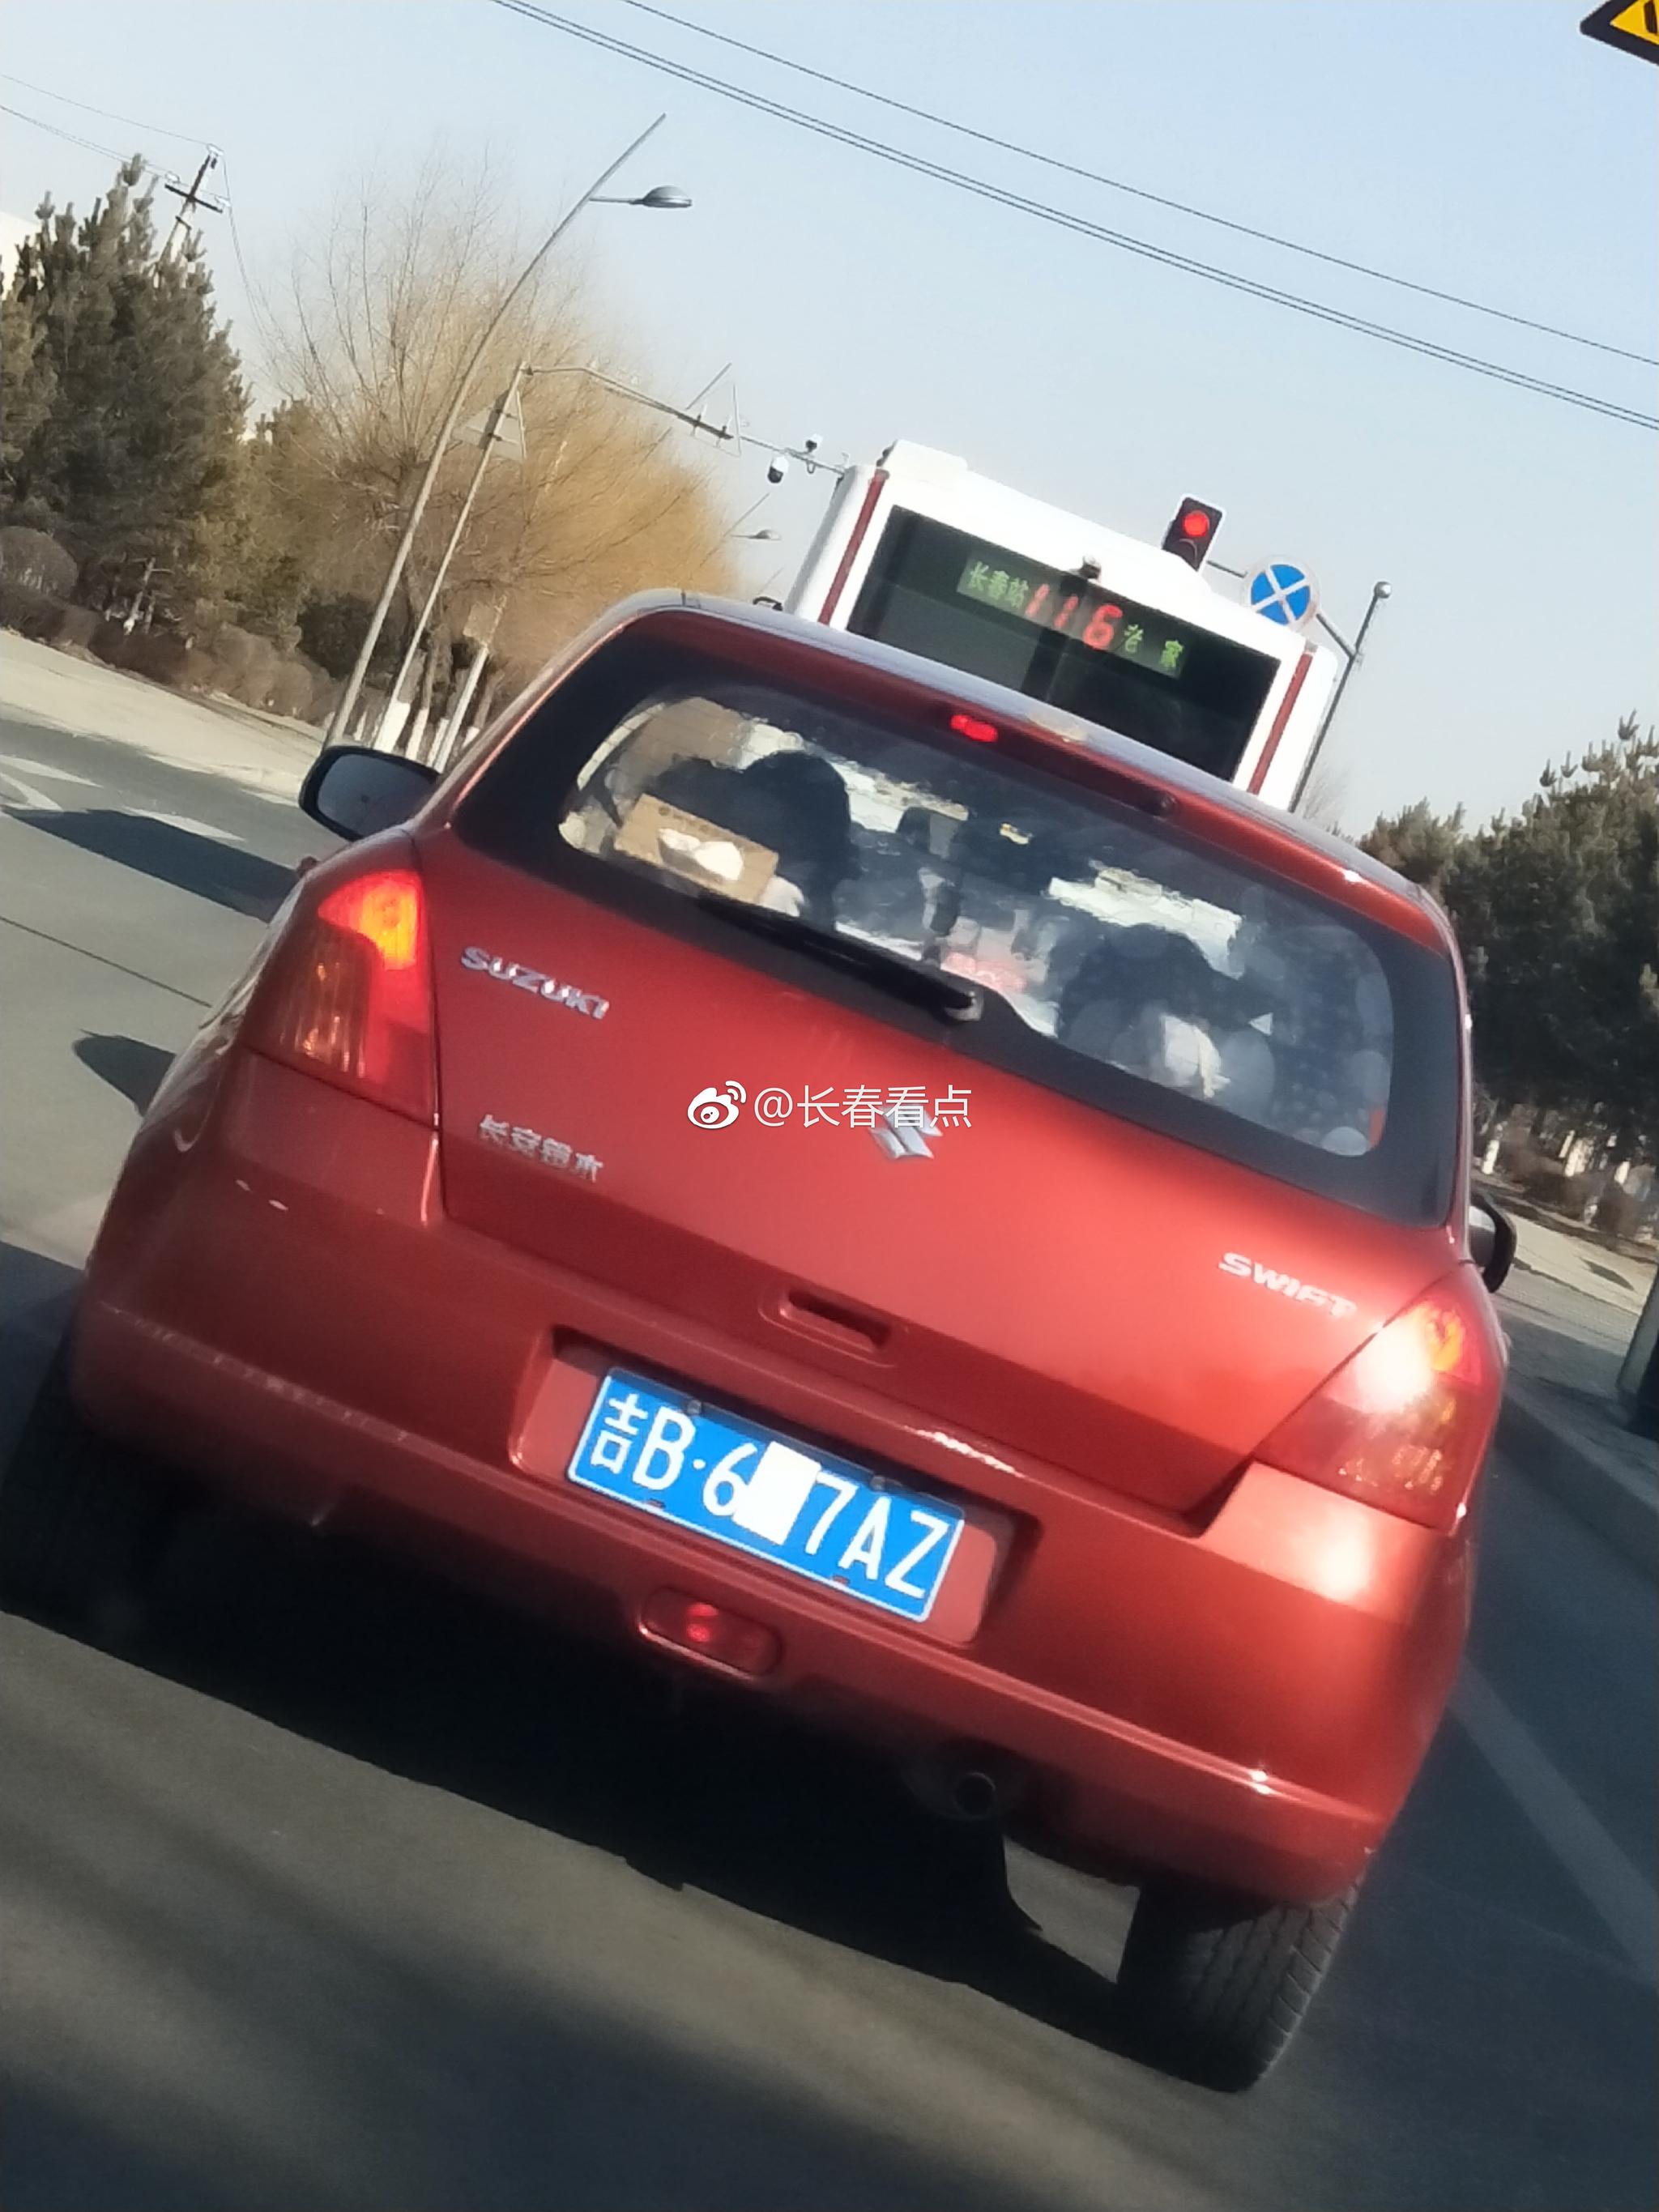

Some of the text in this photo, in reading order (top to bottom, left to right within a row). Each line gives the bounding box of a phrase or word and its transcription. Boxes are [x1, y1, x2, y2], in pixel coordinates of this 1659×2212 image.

[1024, 582, 1124, 650] 116
[461, 946, 609, 1020] SUZUKI
[1218, 1251, 1358, 1318] SWIFT
[590, 1392, 949, 1600] 吉B·67AZ
